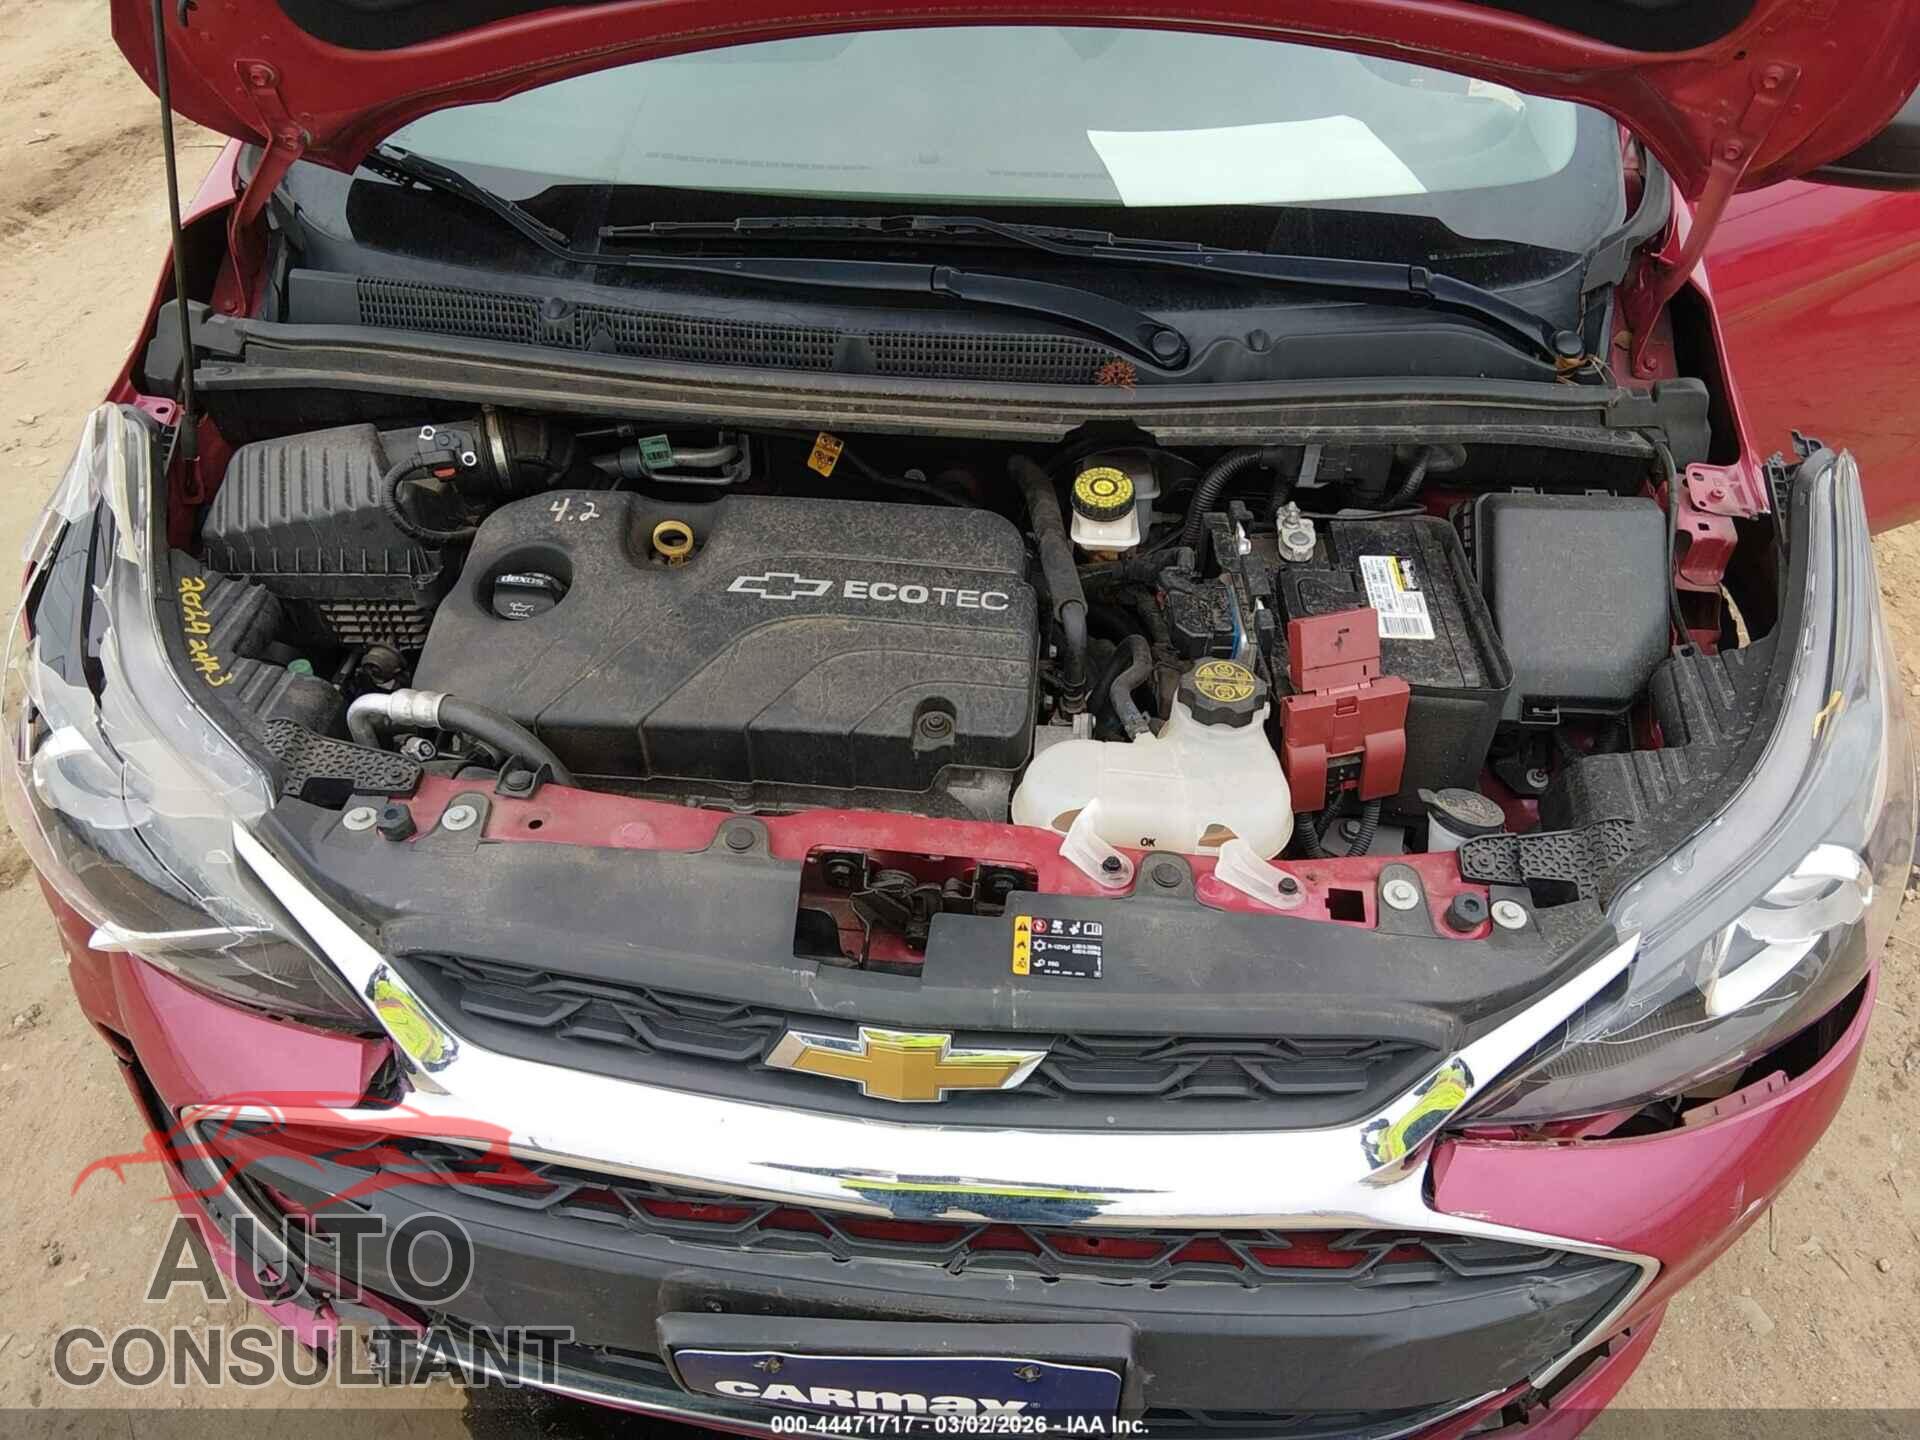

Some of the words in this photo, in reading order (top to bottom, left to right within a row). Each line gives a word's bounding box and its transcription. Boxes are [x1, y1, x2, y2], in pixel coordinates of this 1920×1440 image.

[550, 498, 600, 522] 4.2
[501, 574, 543, 585] dexos
[843, 580, 1009, 611] ECOTEC
[1140, 837, 1156, 847] OK
